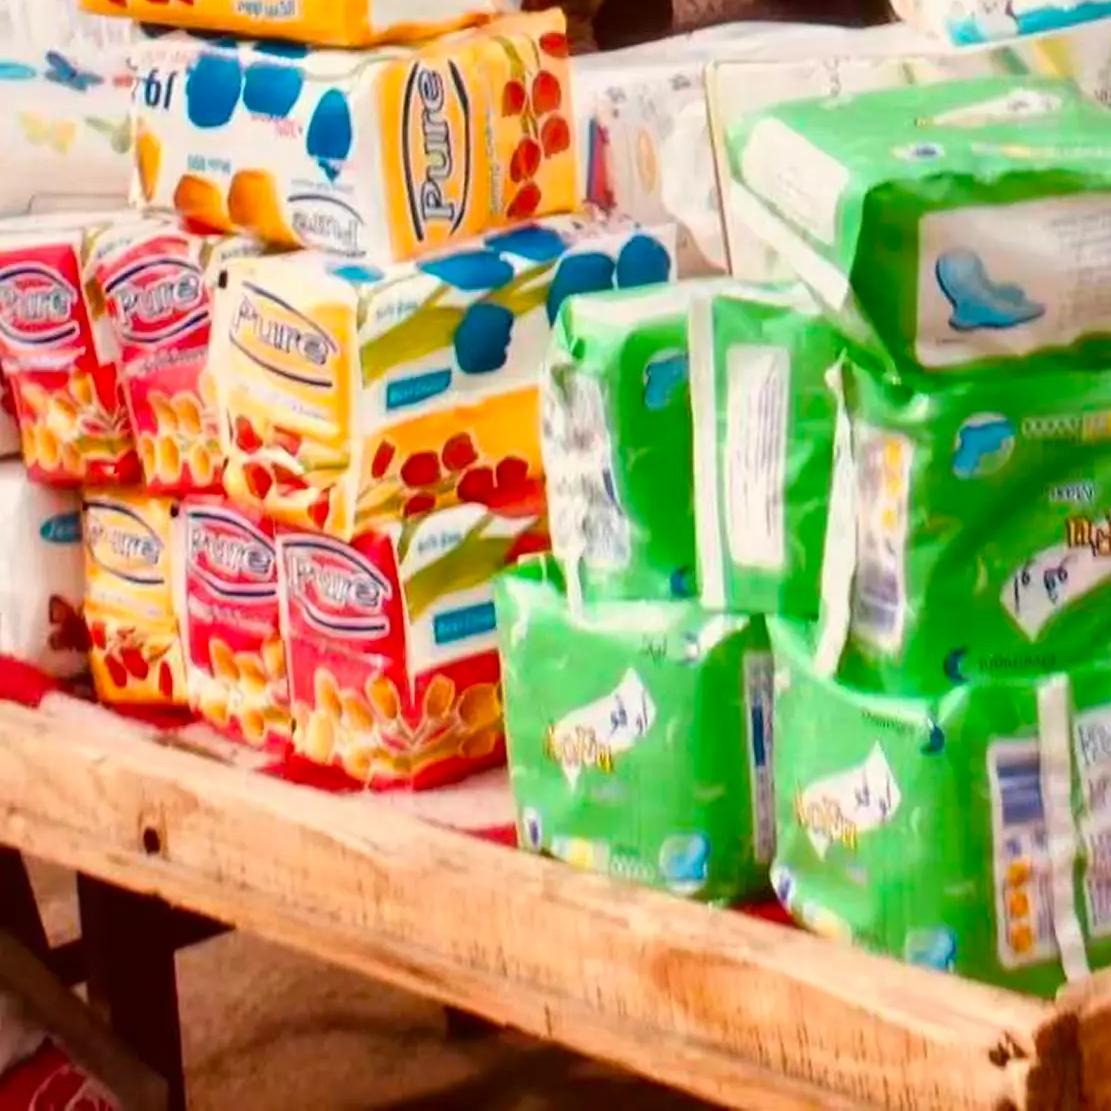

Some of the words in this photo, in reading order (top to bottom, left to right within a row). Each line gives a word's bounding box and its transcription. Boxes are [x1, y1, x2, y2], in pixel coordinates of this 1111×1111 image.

[419, 68, 457, 224] Pure
[114, 271, 201, 334] Pure
[231, 293, 330, 366] Pure
[86, 519, 160, 565] Pure
[188, 519, 272, 575] Pure
[288, 549, 383, 608] Pure
